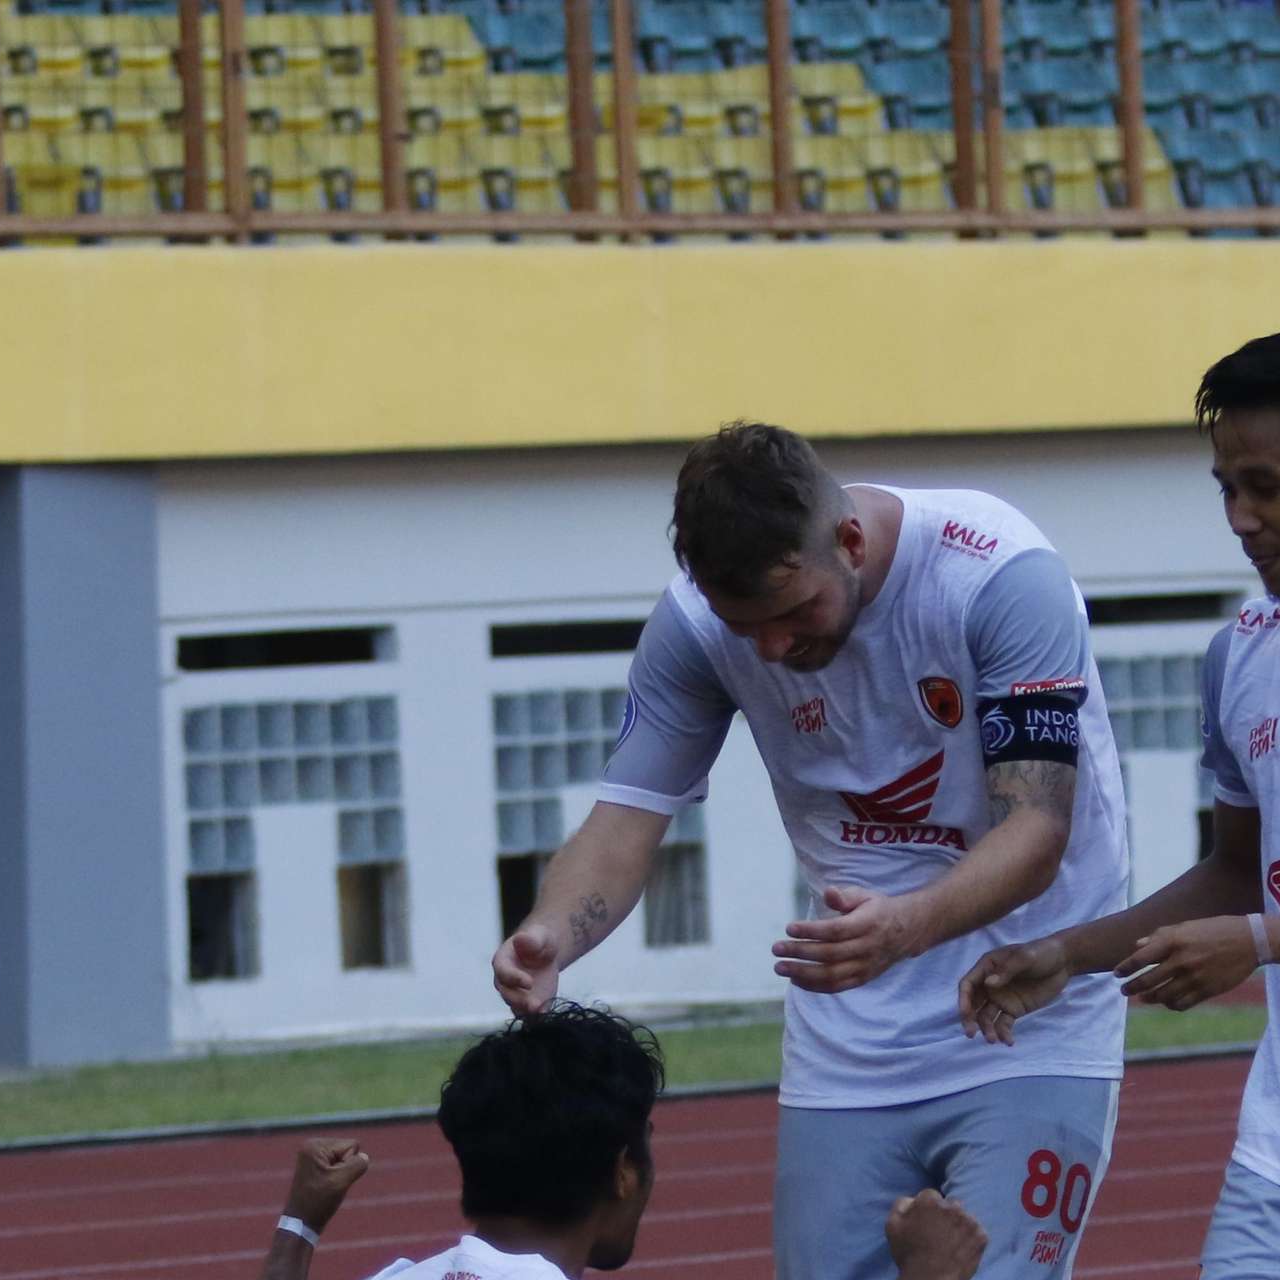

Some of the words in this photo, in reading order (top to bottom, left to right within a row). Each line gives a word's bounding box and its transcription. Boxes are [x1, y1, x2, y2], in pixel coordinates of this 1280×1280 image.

[942, 519, 999, 554] KALLA
[839, 820, 969, 852] HONDA
[1021, 1148, 1092, 1234] 80
